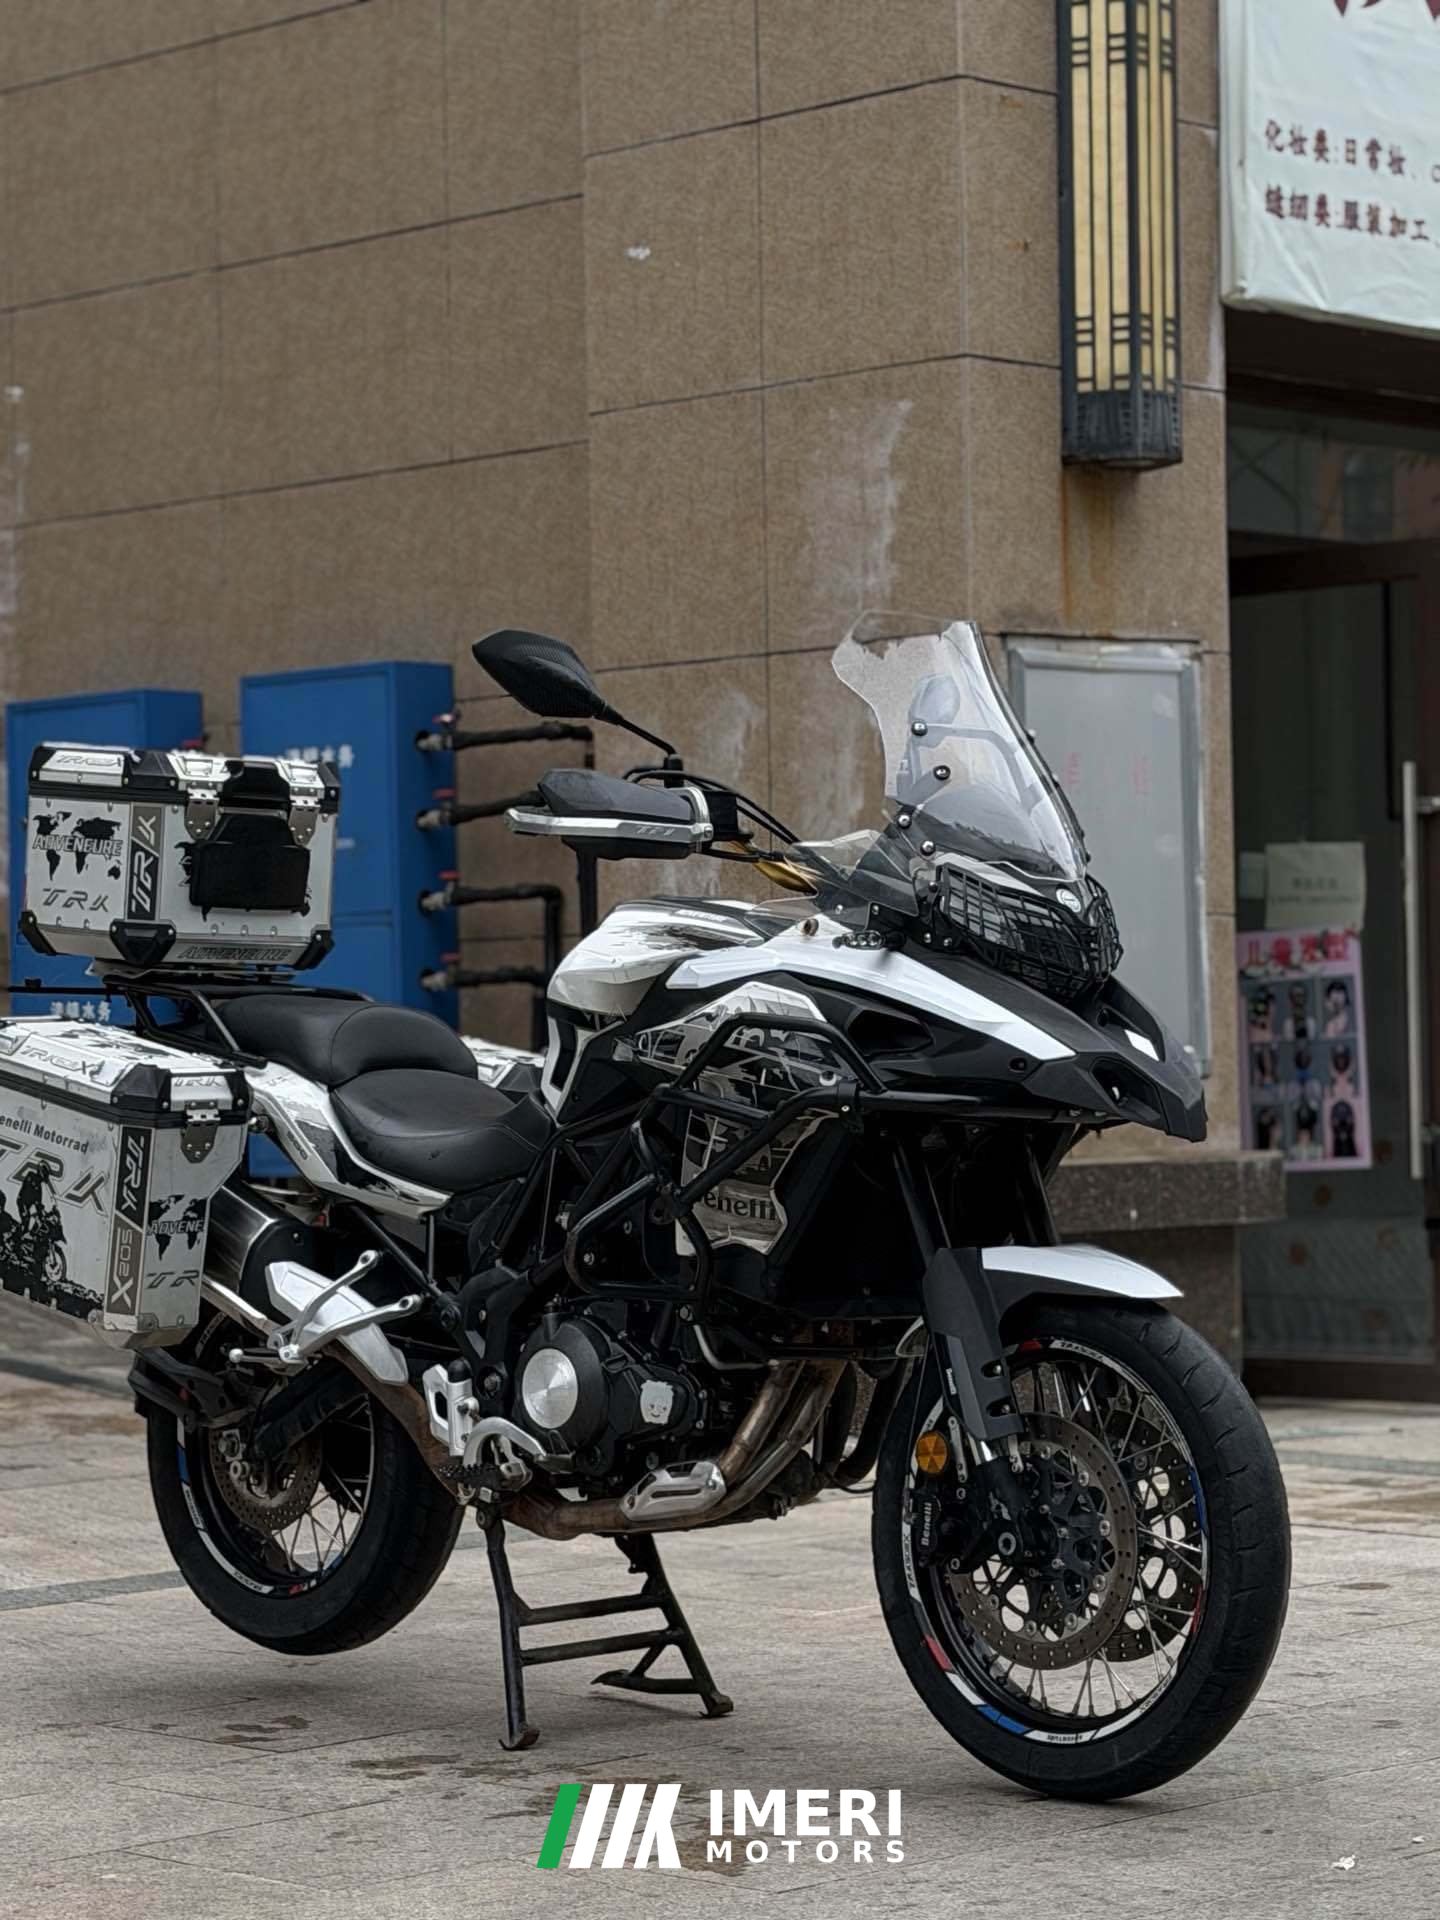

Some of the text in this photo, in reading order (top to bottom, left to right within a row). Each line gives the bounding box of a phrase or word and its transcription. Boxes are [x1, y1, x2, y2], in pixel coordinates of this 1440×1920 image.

[42, 887, 110, 914] TRK
[32, 1122, 90, 1155] Motorrad
[702, 1190, 777, 1220] enelli
[111, 1134, 145, 1310] TRK 502X
[920, 1501, 933, 1547] Benelli
